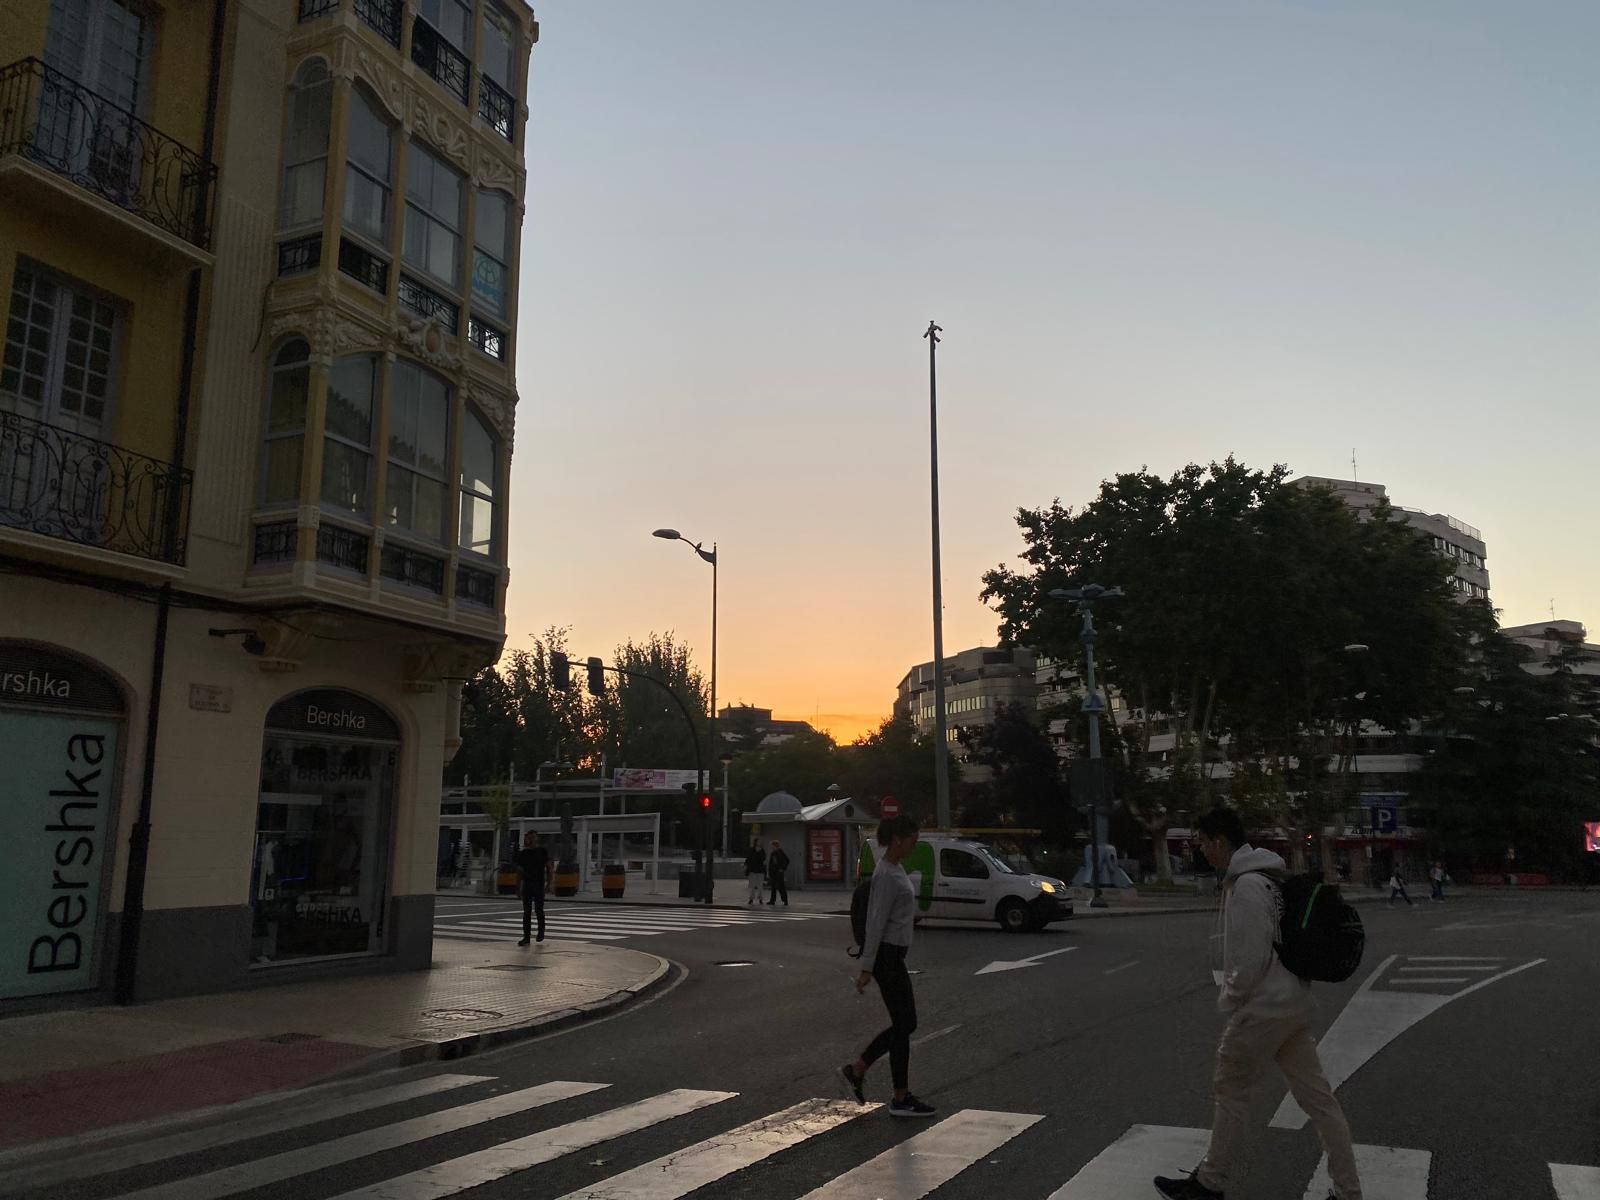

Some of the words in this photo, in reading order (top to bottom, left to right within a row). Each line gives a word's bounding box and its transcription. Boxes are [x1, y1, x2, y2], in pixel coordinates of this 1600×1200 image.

[306, 704, 367, 729] Bershka
[1377, 808, 1392, 829] P
[27, 733, 105, 974] Bershka
